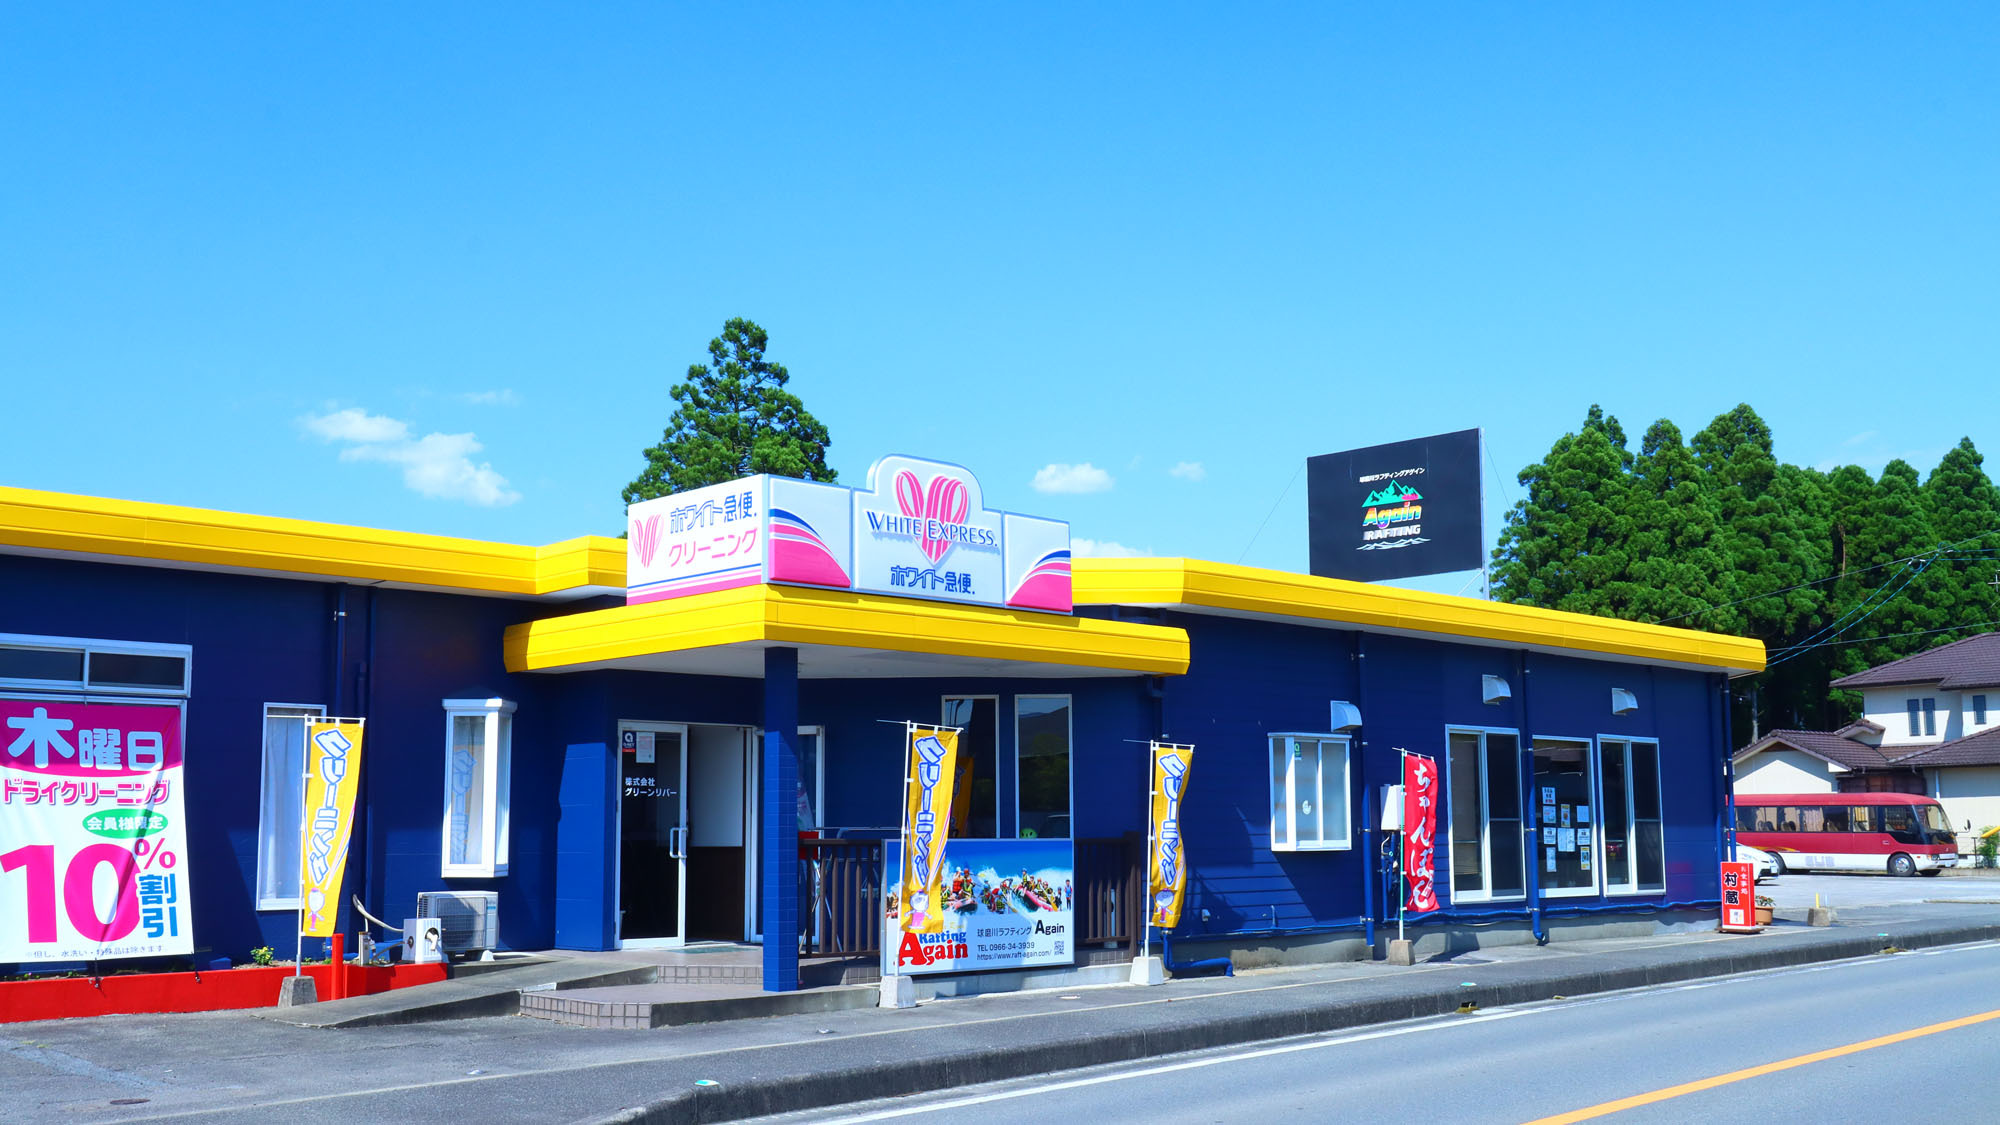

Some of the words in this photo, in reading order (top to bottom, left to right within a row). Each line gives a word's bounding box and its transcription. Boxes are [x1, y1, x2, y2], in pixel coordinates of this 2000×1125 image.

[866, 510, 921, 537] WHITE
[1362, 501, 1422, 529] Again
[1363, 524, 1421, 541] RAFTING
[668, 527, 758, 568] クリーニング
[6, 706, 164, 771] 木曜日
[2, 778, 170, 806] ドライクリーニング
[624, 787, 678, 797] グリーンリバー
[625, 777, 656, 787] 株式会社
[312, 728, 352, 885] クリーニング
[914, 736, 946, 887] クリーニング
[1158, 753, 1188, 887] クリーニング
[86, 815, 165, 831] 会員様限定
[1409, 762, 1433, 910] ちゃんぽん
[1724, 872, 1739, 905] 村蔵
[138, 873, 179, 939] 割引
[977, 927, 1033, 937] 球磨川ラフティング
[1034, 919, 1066, 936] Again
[893, 931, 968, 967] Again
[976, 950, 1053, 961] https://www.raft-again.com/
[977, 944, 988, 952] TEL
[989, 941, 1035, 951] 0966-34-3939
